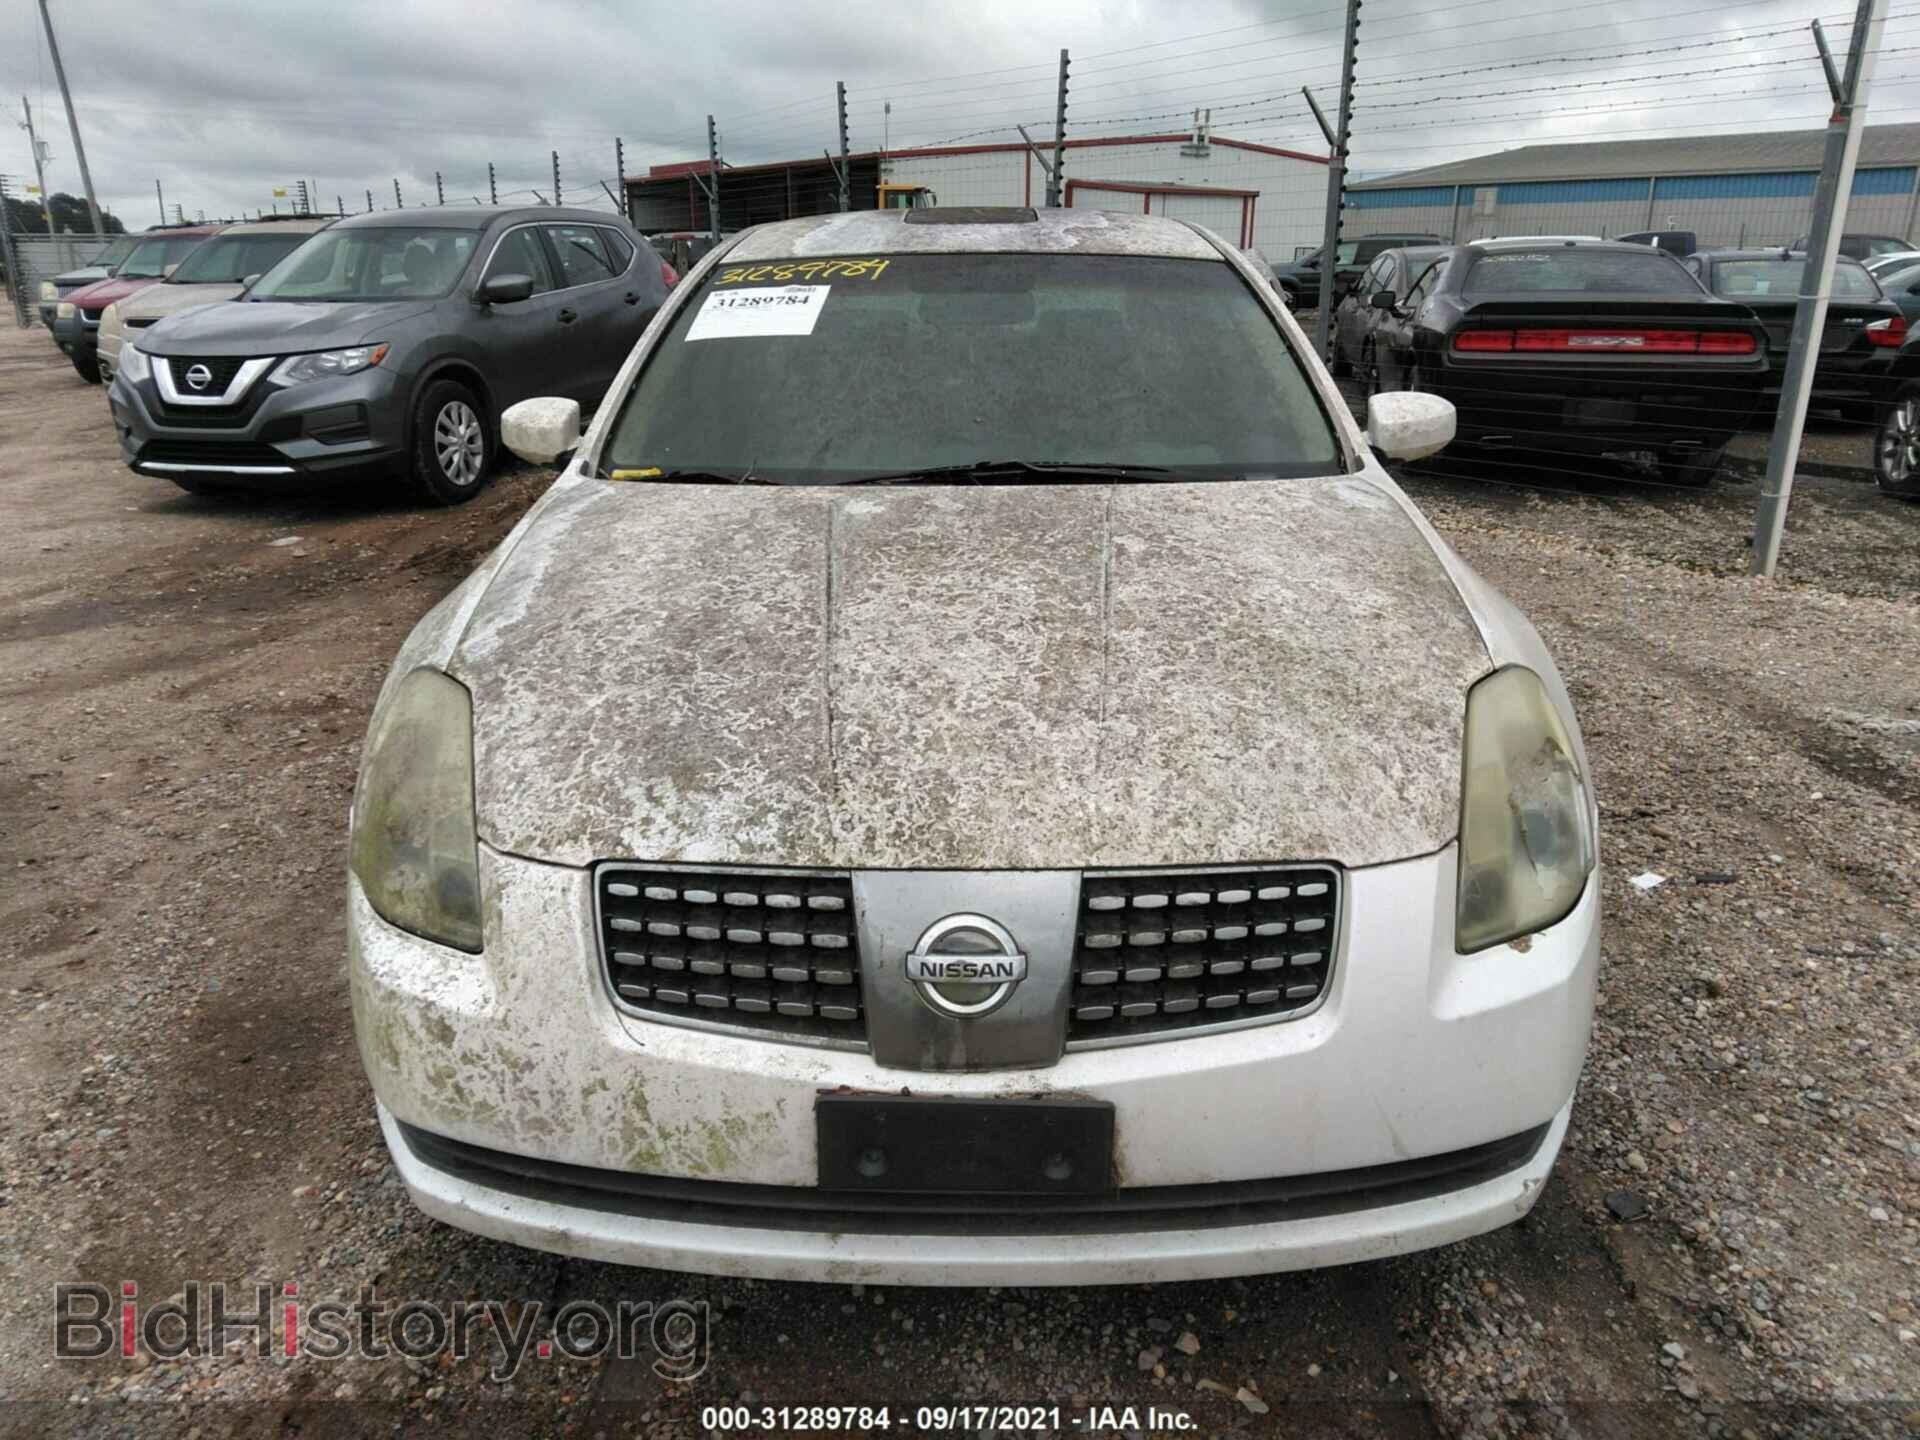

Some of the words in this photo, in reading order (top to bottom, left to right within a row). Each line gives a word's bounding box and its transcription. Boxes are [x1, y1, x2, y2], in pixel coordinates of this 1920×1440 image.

[714, 258, 890, 285] 31289784
[713, 295, 810, 309] 31289784
[919, 961, 1014, 978] NISSAN
